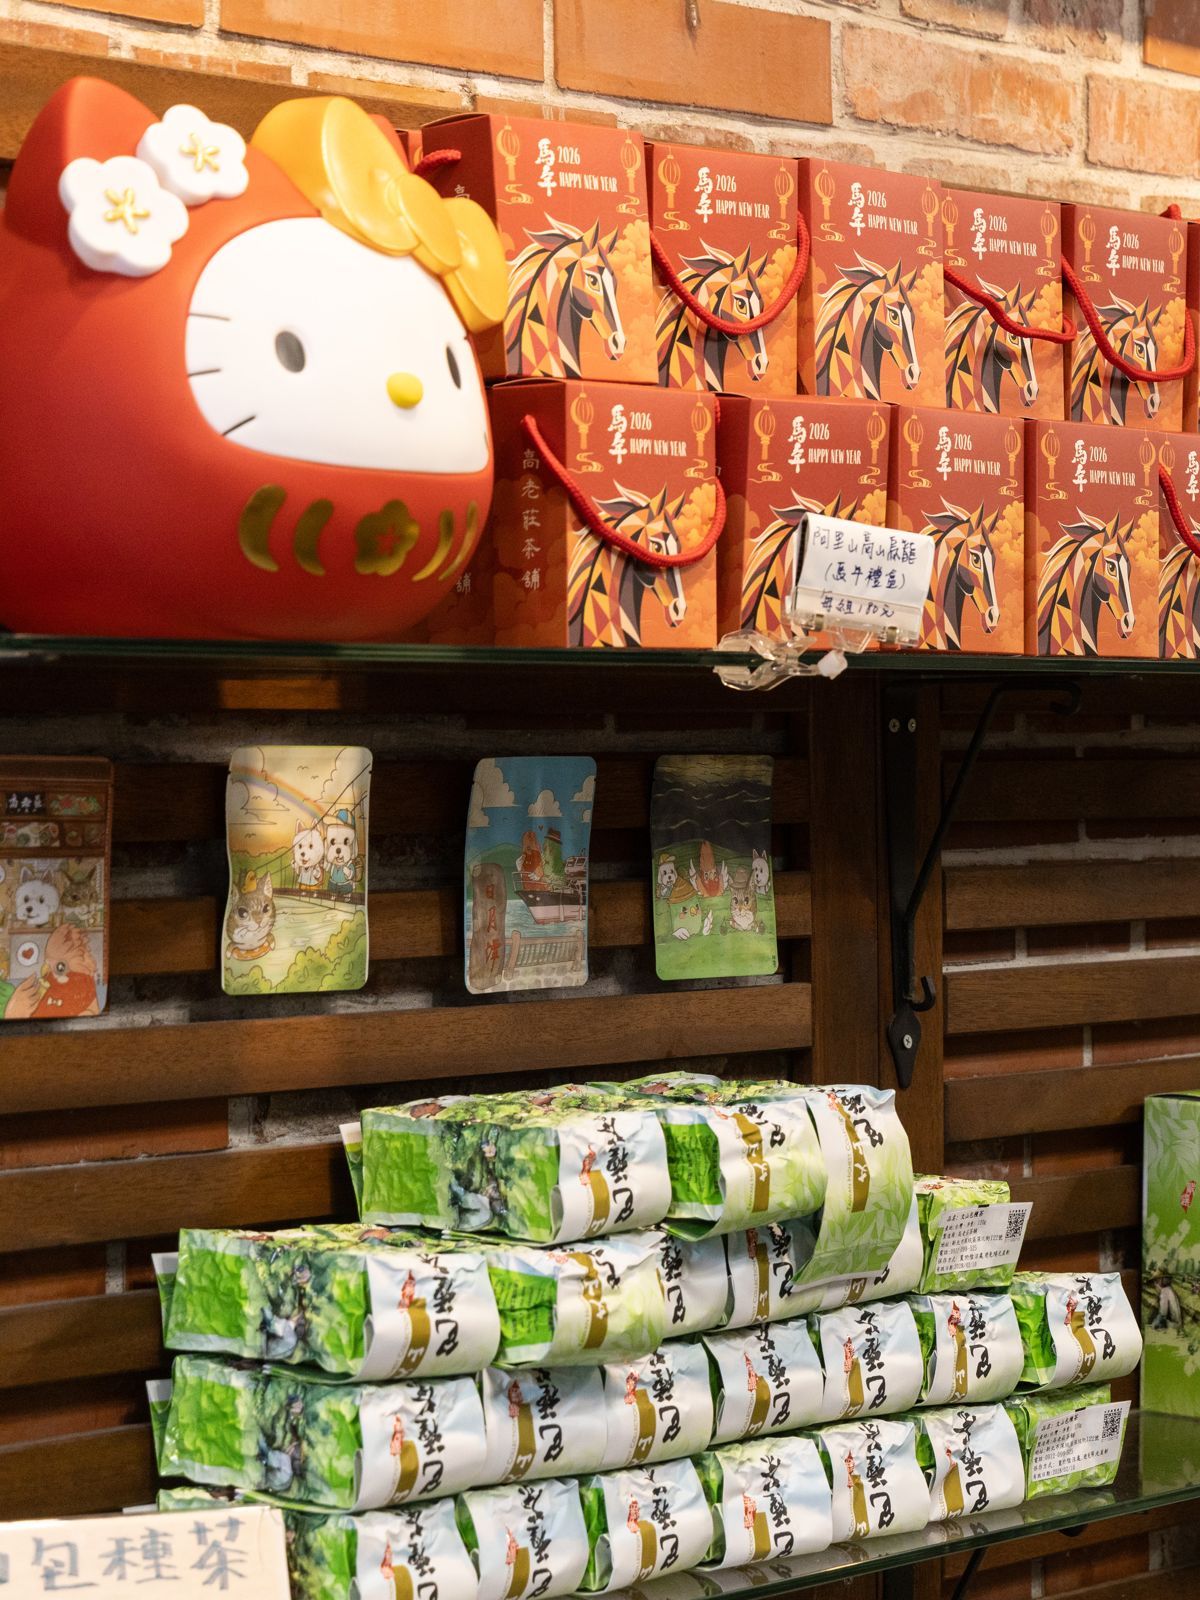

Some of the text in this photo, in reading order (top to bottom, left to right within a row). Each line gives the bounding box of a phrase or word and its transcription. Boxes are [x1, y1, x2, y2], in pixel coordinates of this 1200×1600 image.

[535, 138, 557, 197] 馬年
[557, 146, 580, 165] 2026
[559, 172, 618, 192] HAPPY NEW YEAR
[694, 167, 713, 223] 馬年
[716, 175, 736, 192] 2026
[867, 190, 886, 208] 2026
[715, 200, 770, 219] HAPPY NEW YEAR
[848, 182, 865, 236] 馬年
[868, 214, 918, 235] HAPPY NEW YEAR
[970, 208, 987, 260] 馬年
[989, 215, 1007, 232] 2026
[989, 238, 1037, 256] HAPPY NEW YEAR
[1106, 226, 1121, 276] 馬年
[1122, 255, 1165, 273] HAPPY NEW YEAR
[1123, 233, 1139, 250] 2026
[608, 404, 628, 464] 馬年
[630, 412, 652, 430] 2026
[788, 416, 806, 473] 馬年
[809, 423, 830, 440] 2026
[954, 434, 972, 451] 2026
[630, 438, 686, 457] HAPPY NEW YEAR
[808, 448, 861, 465] HAPPY NEW YEAR
[935, 426, 952, 481] 馬年
[954, 458, 1000, 476] HAPPY NEW YEAR
[1072, 440, 1087, 492] 馬年
[1090, 446, 1107, 463] 2026
[1090, 470, 1135, 486] HAPPY NEW YEAR
[1185, 451, 1199, 501] 馬年
[841, 1094, 884, 1148] 包種
[597, 1115, 634, 1224] 包種茶
[1075, 1275, 1116, 1360] 包種茶
[855, 1310, 887, 1410] 包種茶
[406, 1382, 445, 1495] 包種茶
[953, 1411, 990, 1513] 包種茶
[859, 1422, 895, 1529] 包種茶
[760, 1455, 794, 1558] 包種茶
[0, 1516, 248, 1591] 包種茶
[518, 1487, 553, 1600] 包種茶
